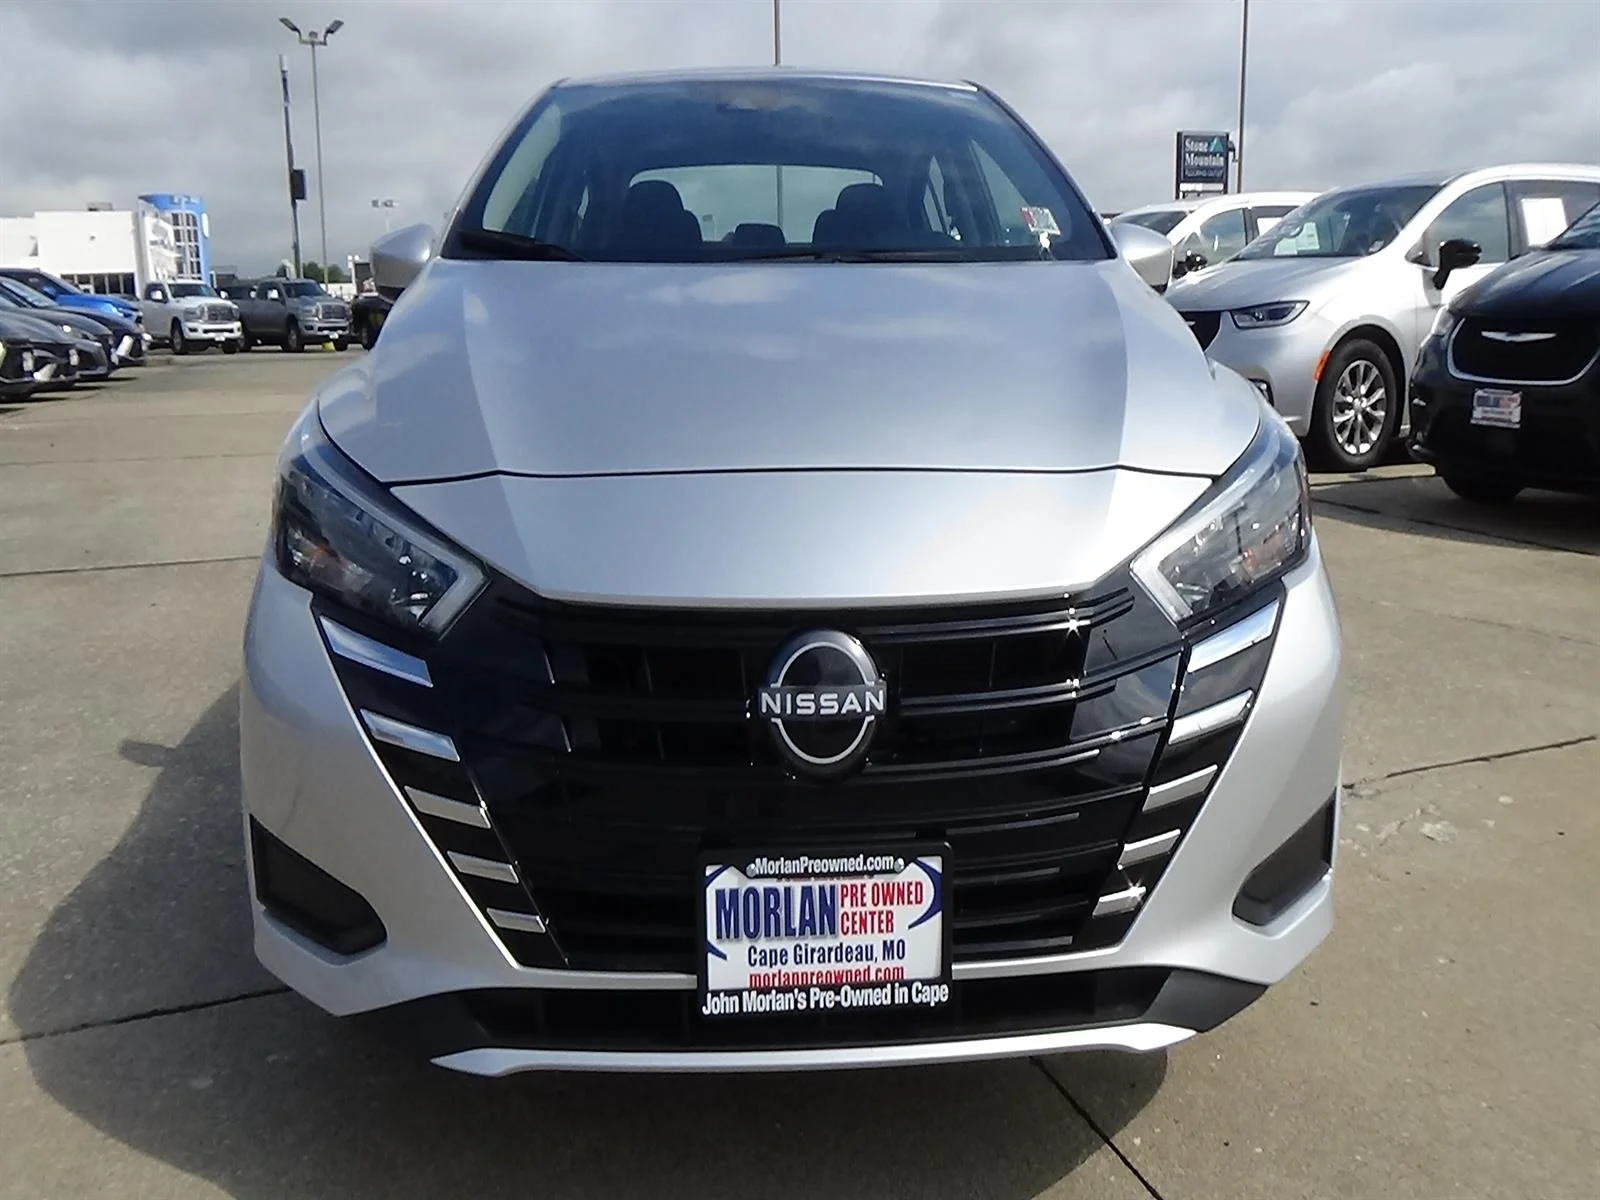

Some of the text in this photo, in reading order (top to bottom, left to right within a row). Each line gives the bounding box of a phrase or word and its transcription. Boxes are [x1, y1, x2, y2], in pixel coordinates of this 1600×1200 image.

[1185, 153, 1224, 166] Mountain
[761, 689, 884, 715] NISSAN
[755, 854, 895, 875] MorlanPreowned.com
[840, 881, 924, 907] PRE OWNED
[715, 884, 837, 939] MORLAN
[840, 910, 895, 936] CENTER
[748, 939, 906, 968] Cape Girardeau, MO
[702, 981, 950, 1015] John Morlan's Pre-Owned in Cape
